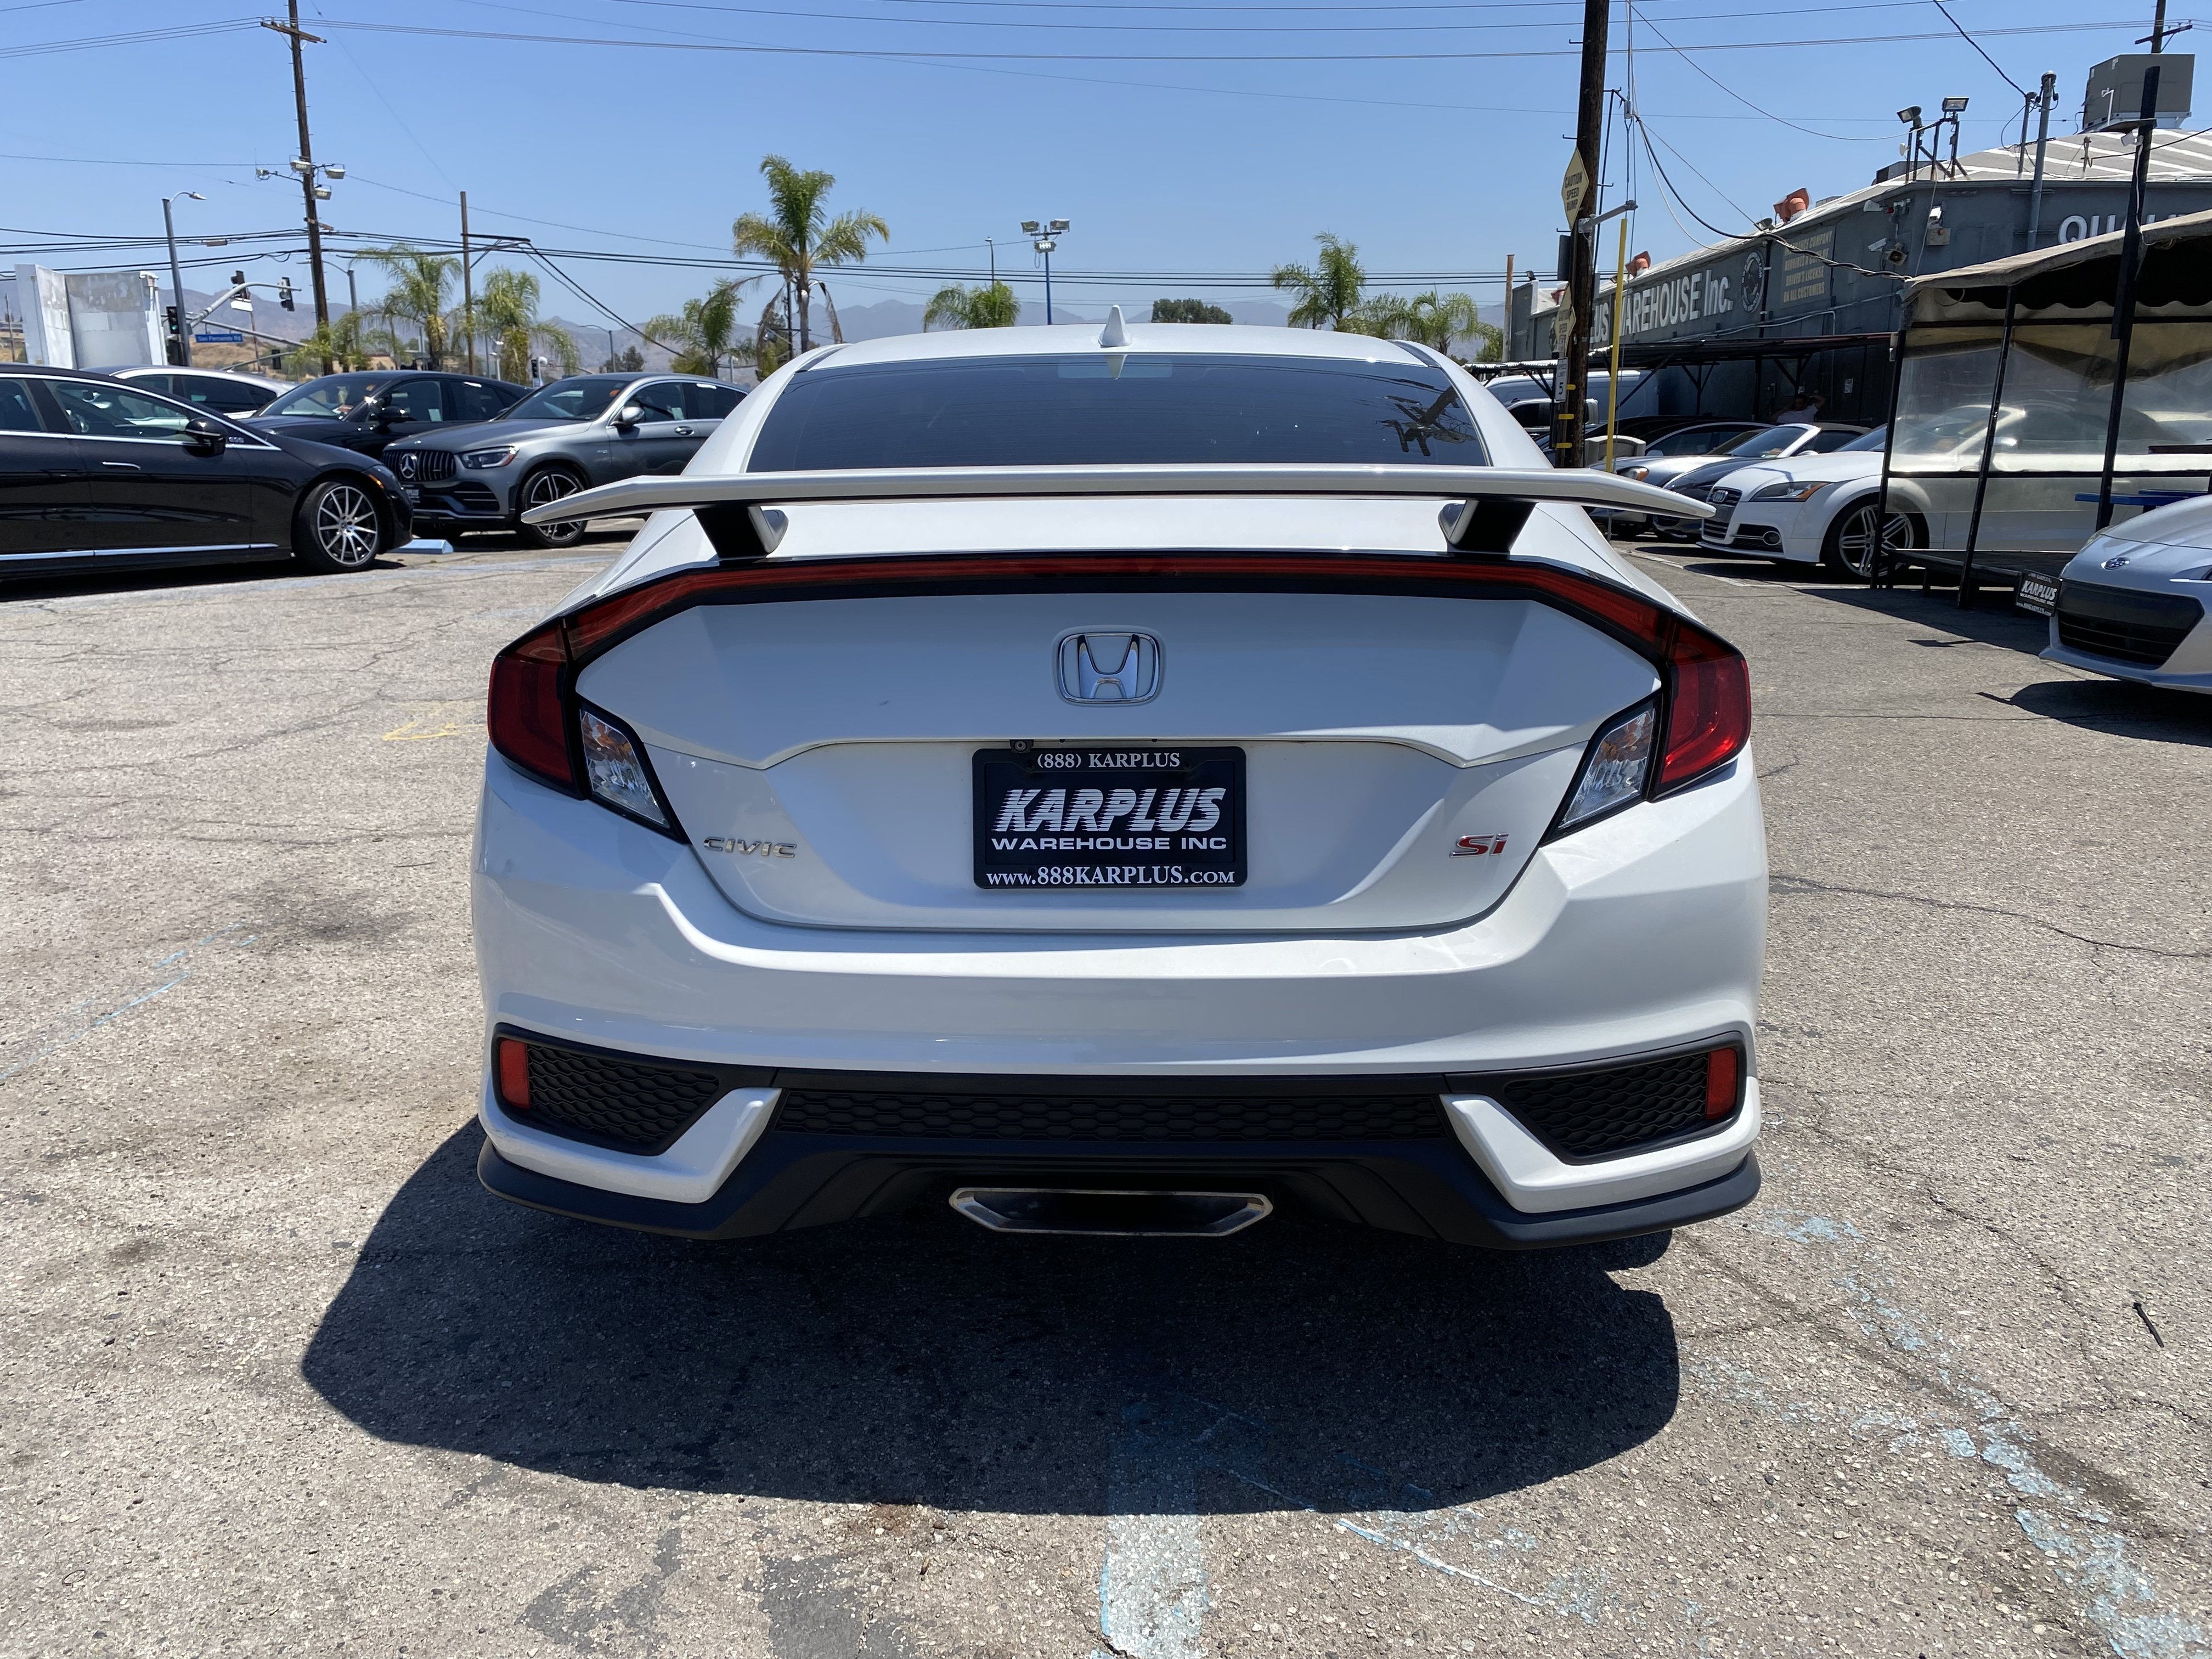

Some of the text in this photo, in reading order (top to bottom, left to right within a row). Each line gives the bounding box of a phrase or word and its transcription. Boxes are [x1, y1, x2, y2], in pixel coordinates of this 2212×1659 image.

[1565, 171, 1583, 188] CAUTION
[1567, 187, 1579, 200] SPEED
[1567, 199, 1578, 211] BUMP
[1809, 230, 1832, 248] COMPANY
[1805, 266, 1824, 281] LICENSE
[1704, 269, 1733, 317] Inc.
[1798, 281, 1825, 299] CUSTOMERS
[1559, 382, 1564, 394] 5
[2021, 580, 2057, 600] KARPLUS
[1037, 753, 1180, 768] (888) KARPLUS
[991, 787, 1227, 832] KARPLUS
[703, 836, 797, 858] CIVIC
[991, 837, 1227, 850] WAREHOUSE INC
[1449, 833, 1509, 857] Si
